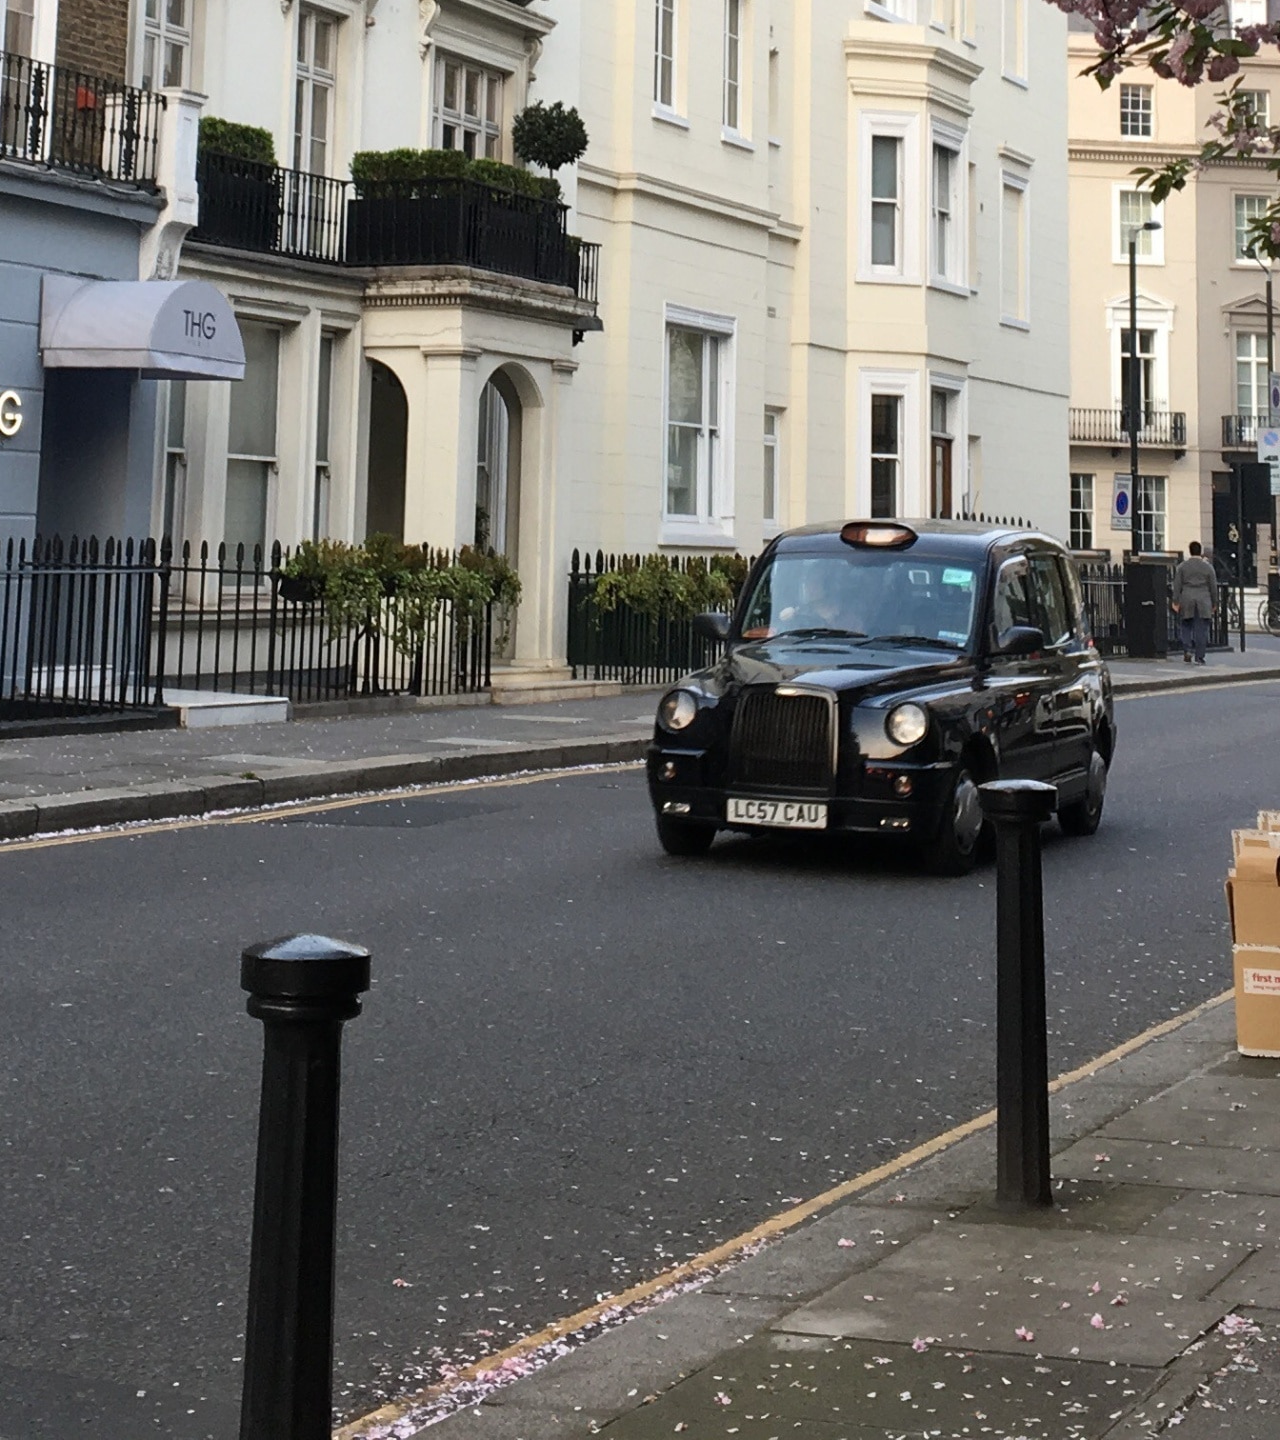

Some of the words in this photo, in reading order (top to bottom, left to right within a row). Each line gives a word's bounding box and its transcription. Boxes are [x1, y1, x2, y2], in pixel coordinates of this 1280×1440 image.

[183, 310, 215, 339] THG
[734, 800, 779, 820] LC57
[784, 804, 819, 823] CAU
[1252, 972, 1273, 983] first
